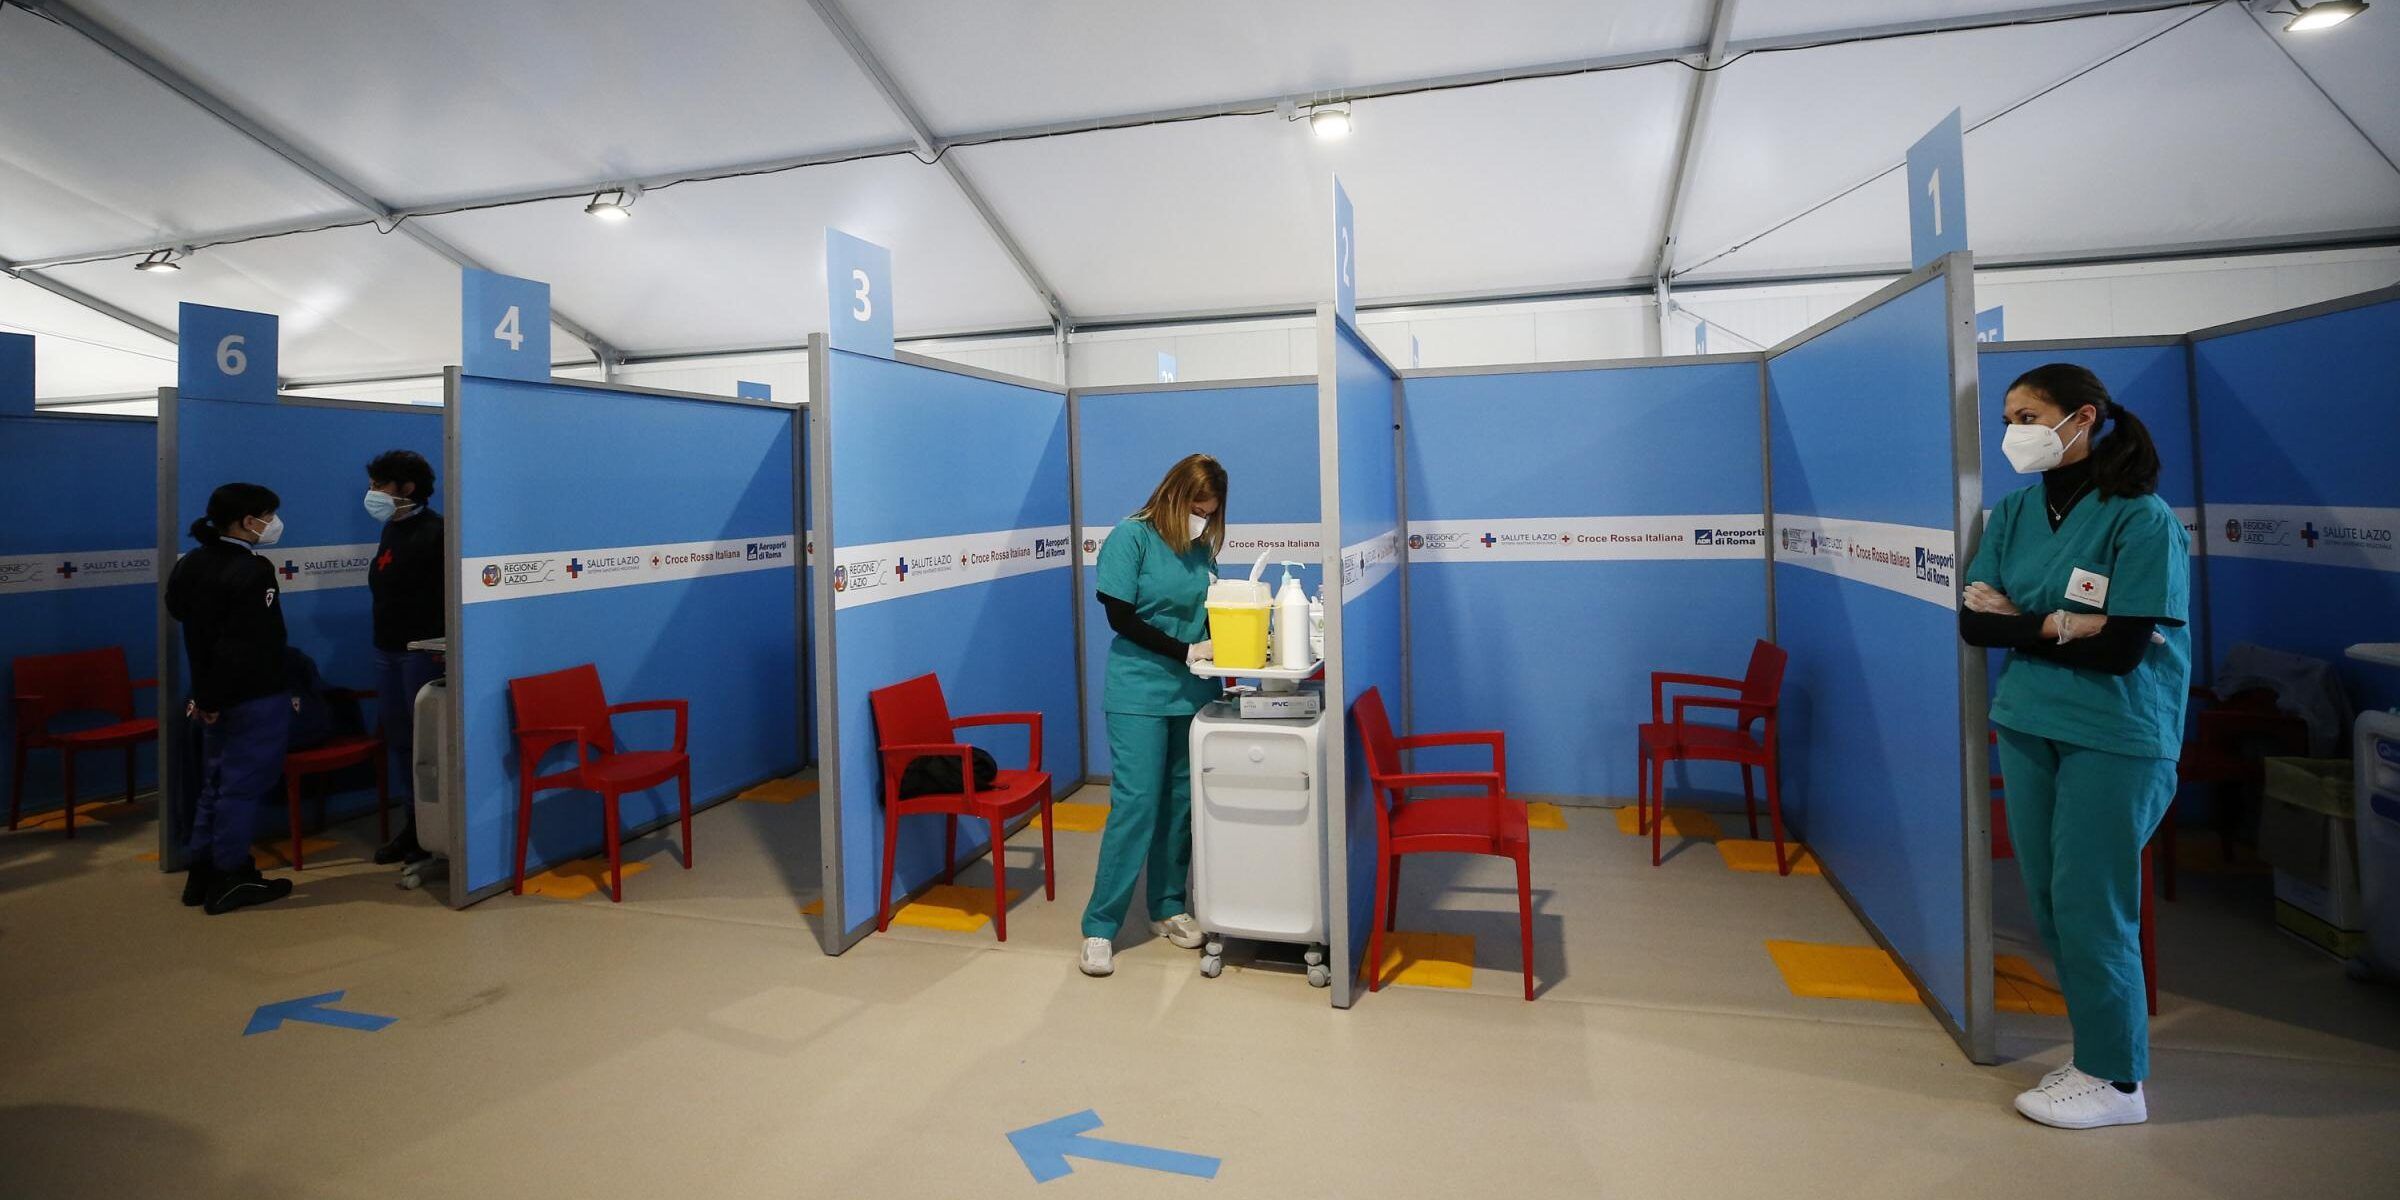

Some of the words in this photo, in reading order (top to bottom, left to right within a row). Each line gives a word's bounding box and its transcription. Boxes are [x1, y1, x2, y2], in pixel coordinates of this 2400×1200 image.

[1928, 168, 1942, 236] 1
[1342, 226, 1350, 288] 2
[853, 269, 872, 321] 3
[494, 305, 524, 351] 4
[216, 334, 247, 376] 6
[1532, 533, 1557, 541] LAZIO
[1577, 534, 1607, 543] Croce
[1610, 534, 1643, 542] Rossa
[1645, 534, 1683, 542] Italiana
[1715, 529, 1765, 538] Aeroporti
[2244, 533, 2264, 542] LAZIO
[2323, 526, 2357, 539] SALUTE
[2360, 528, 2391, 542] LAZIO
[759, 541, 786, 550] Aeroporti
[1046, 537, 1069, 548] Aeroporti
[1228, 540, 1255, 548] Croce
[1257, 540, 1285, 548] Rossa
[1287, 539, 1320, 548] Italiana
[1715, 537, 1725, 545] di
[665, 553, 688, 565] Croce
[691, 551, 713, 562] Rossa
[715, 550, 740, 560] Italiana
[759, 552, 765, 560] di
[766, 551, 781, 559] Roma
[911, 557, 932, 569] SALUTE
[934, 554, 952, 566] LAZIO
[971, 553, 989, 564] Croce
[991, 551, 1010, 561] Rossa
[1010, 547, 1031, 559] Italiana
[1856, 545, 1872, 560] Croce
[1872, 547, 1889, 564] Rossa
[1889, 549, 1910, 568] Italiana
[1926, 548, 1954, 569] Aeroporti
[82, 560, 118, 570] SALUTE
[122, 559, 150, 568] LAZIO
[304, 560, 338, 570] SALUTE
[341, 557, 369, 568] LAZIO
[504, 563, 538, 573] REGIONE
[587, 558, 615, 569] SALUTE
[617, 556, 640, 566] LAZIO
[849, 563, 875, 575] REGIONE
[504, 575, 528, 584] LAZIO
[849, 577, 867, 588] LAZIO
[1927, 567, 1933, 582] di
[1933, 569, 1950, 587] Roma
